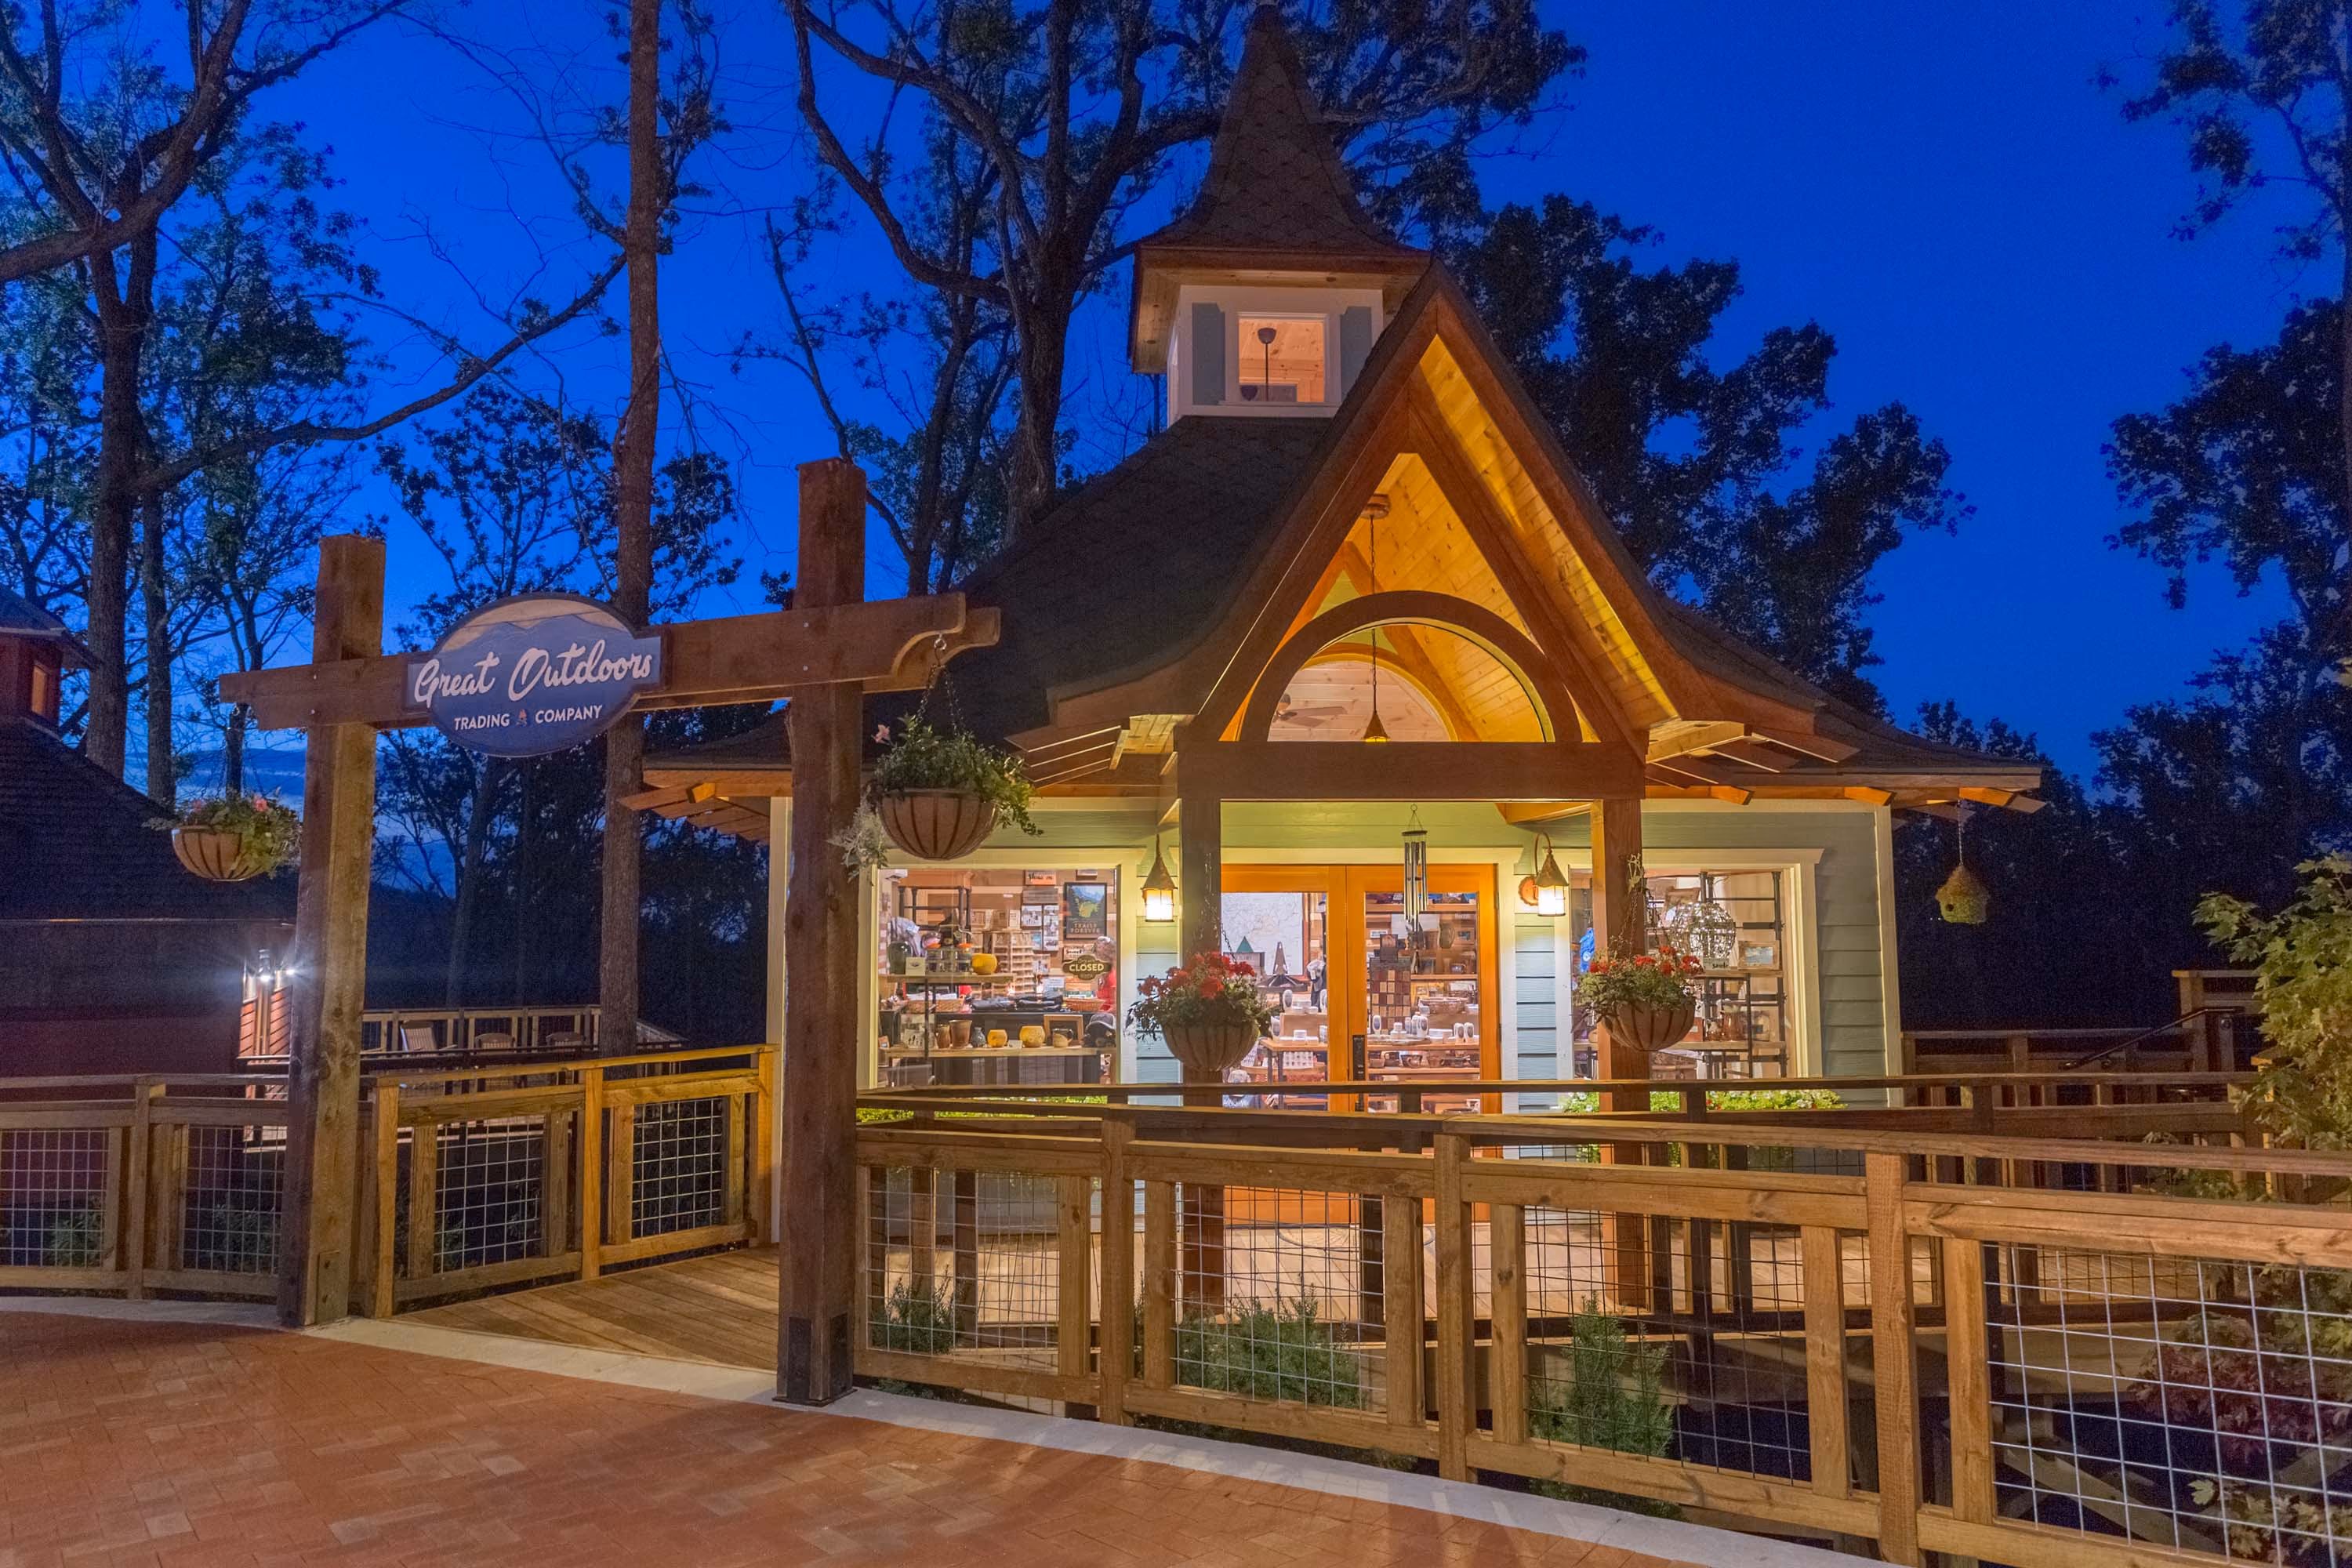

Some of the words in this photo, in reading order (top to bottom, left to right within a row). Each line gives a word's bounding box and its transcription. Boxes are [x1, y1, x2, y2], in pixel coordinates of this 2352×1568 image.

[414, 652, 500, 708] Great
[508, 639, 653, 702] Outdoors
[454, 713, 510, 731] TRADING
[535, 705, 603, 724] COMPANY
